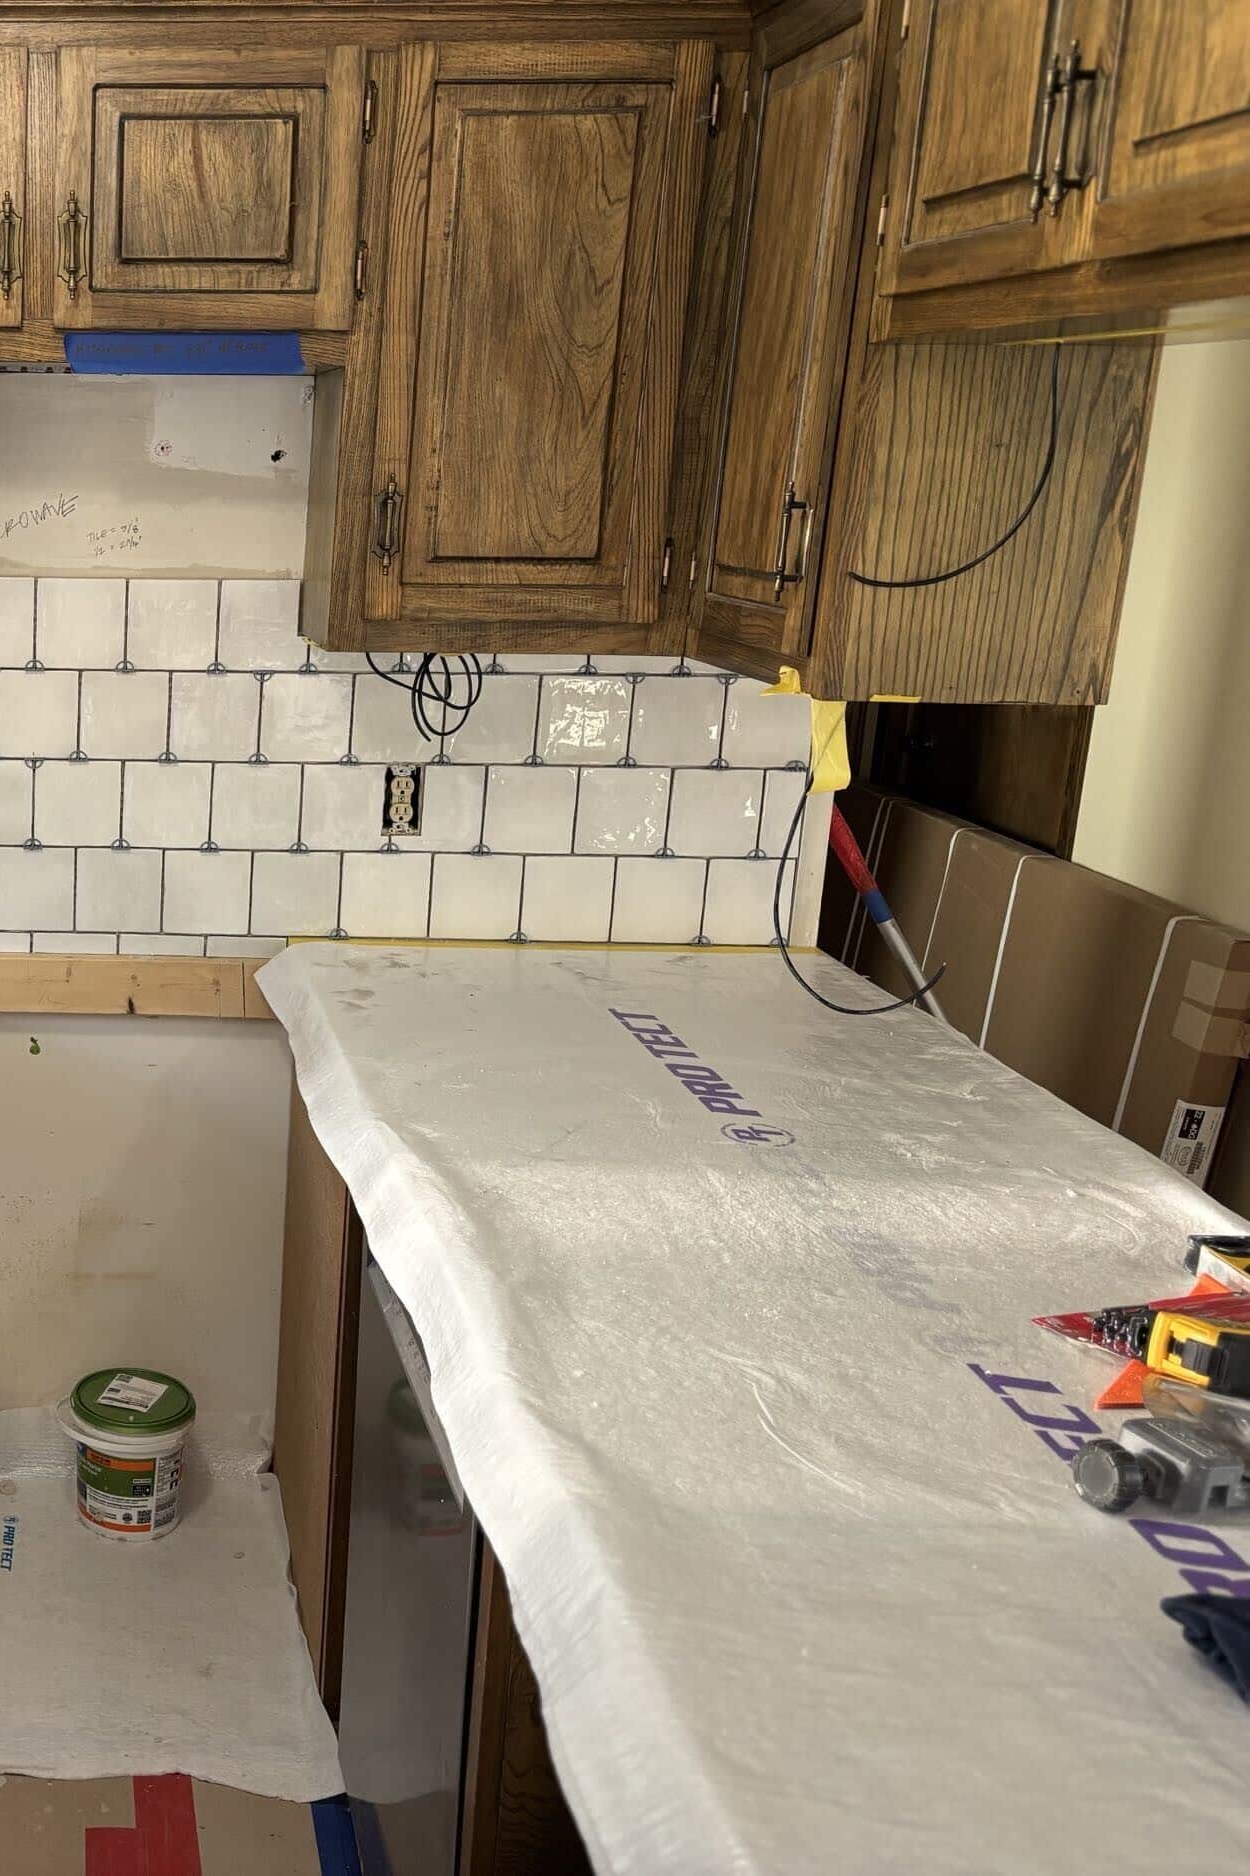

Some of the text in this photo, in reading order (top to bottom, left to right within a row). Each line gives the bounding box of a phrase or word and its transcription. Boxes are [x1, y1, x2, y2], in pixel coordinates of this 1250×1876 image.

[87, 529, 107, 542] TILE
[608, 1008, 699, 1059] TECT
[664, 1063, 763, 1117] PRO
[3, 1525, 15, 1545] PRO
[0, 1548, 13, 1571] TECT
